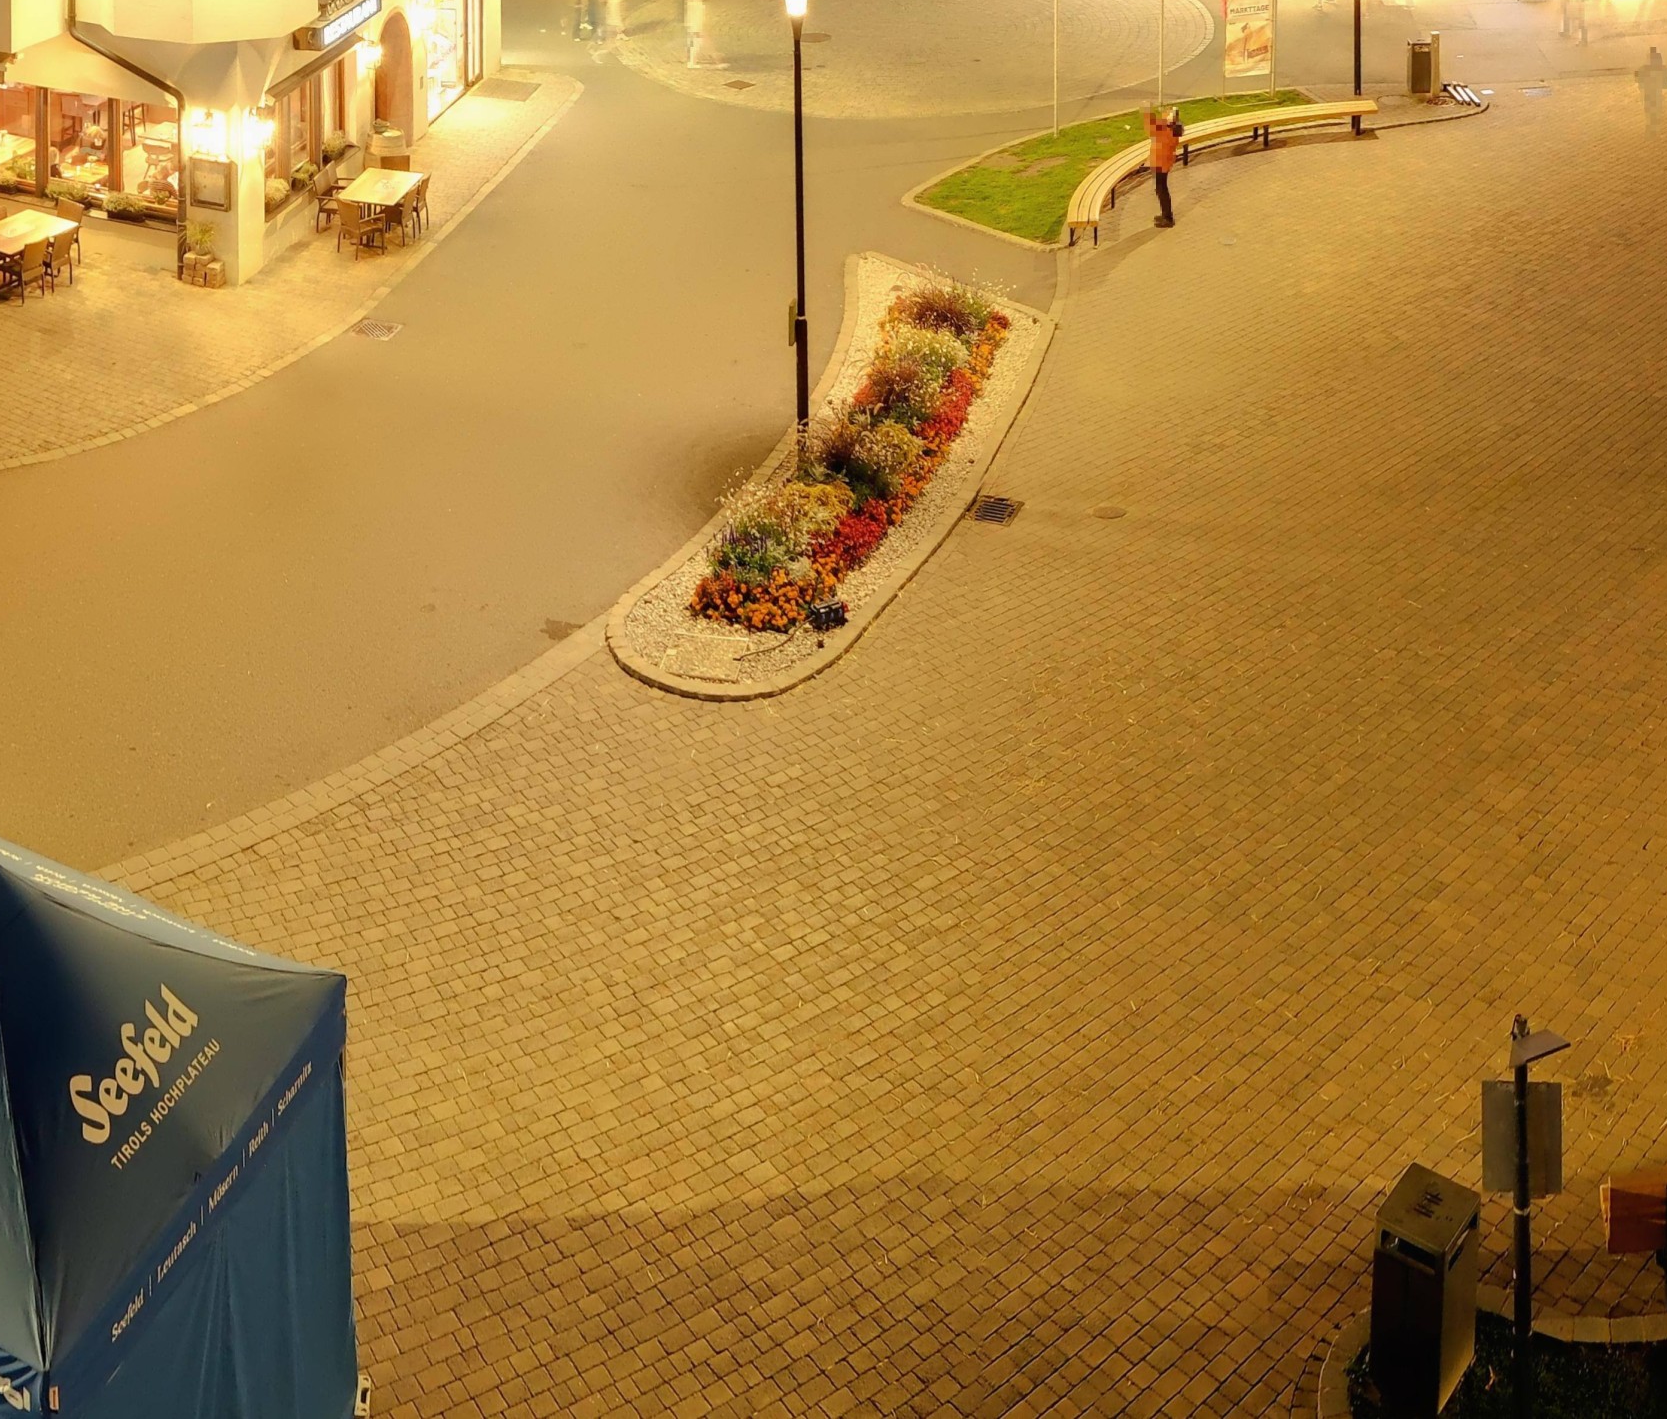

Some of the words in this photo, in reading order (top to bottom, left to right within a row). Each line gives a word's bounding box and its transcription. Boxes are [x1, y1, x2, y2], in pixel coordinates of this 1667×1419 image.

[1229, 4, 1270, 15] MARKTTAGE
[69, 982, 199, 1145] Seefeld
[110, 1121, 152, 1170] TIROLS
[149, 1038, 221, 1125] HOCHPLATEAU
[111, 1287, 145, 1343] Seefeld
[157, 1221, 197, 1284] Leutasch
[208, 1164, 239, 1214] Mösern
[248, 1120, 270, 1159] Reith
[277, 1061, 313, 1117] Scharnitz
